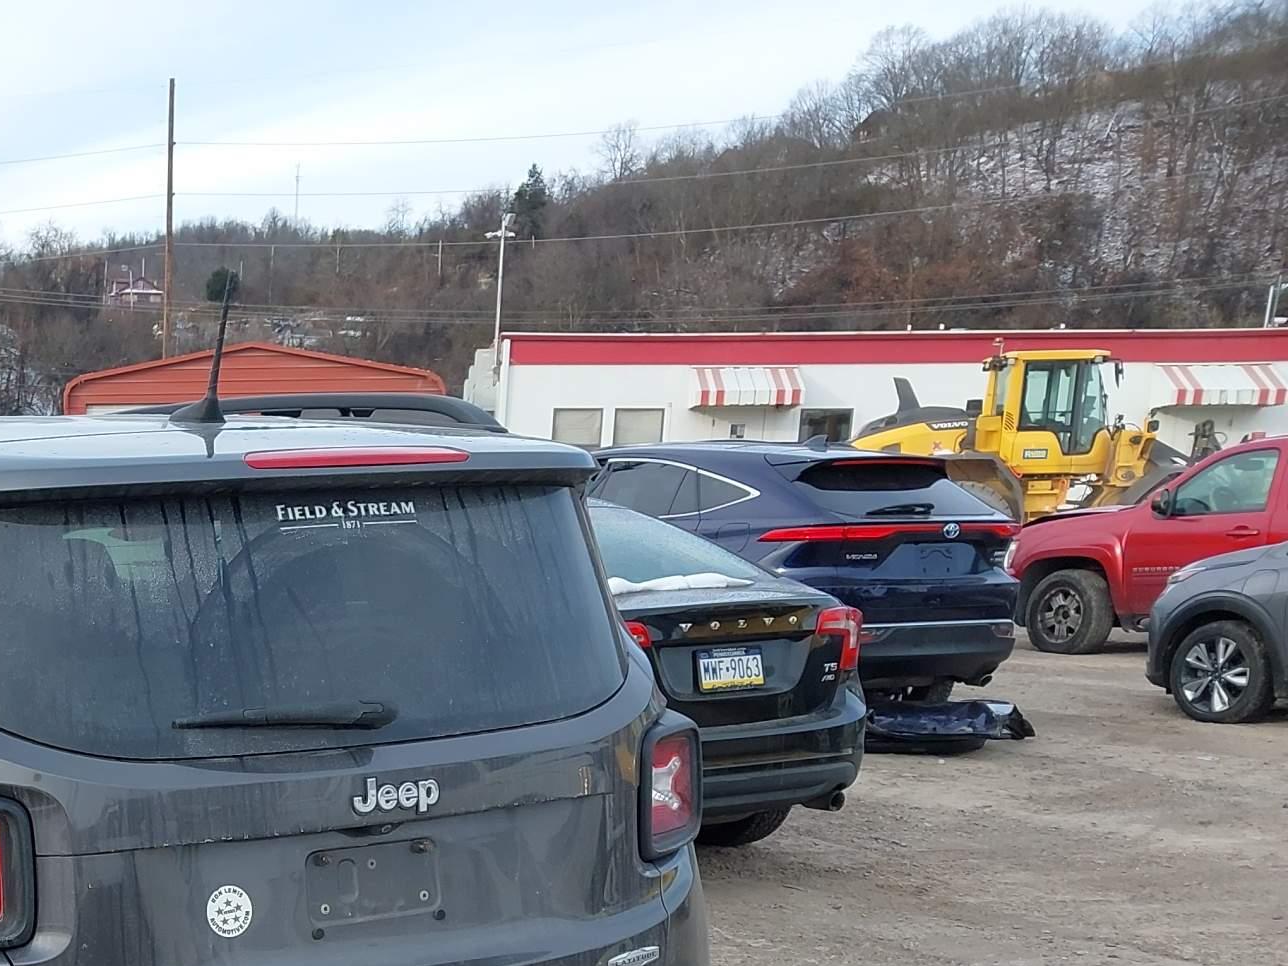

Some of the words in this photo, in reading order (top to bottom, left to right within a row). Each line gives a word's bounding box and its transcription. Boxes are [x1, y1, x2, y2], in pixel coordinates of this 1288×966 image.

[932, 421, 969, 430] VOLVO
[275, 504, 327, 521] FIELD
[331, 501, 344, 517] &
[347, 500, 416, 517] STREAM
[342, 520, 361, 529] 1871
[678, 615, 798, 633] VOLVO
[823, 661, 838, 673] T5
[353, 777, 440, 813] Jeep
[615, 950, 657, 966] LATITUDE
